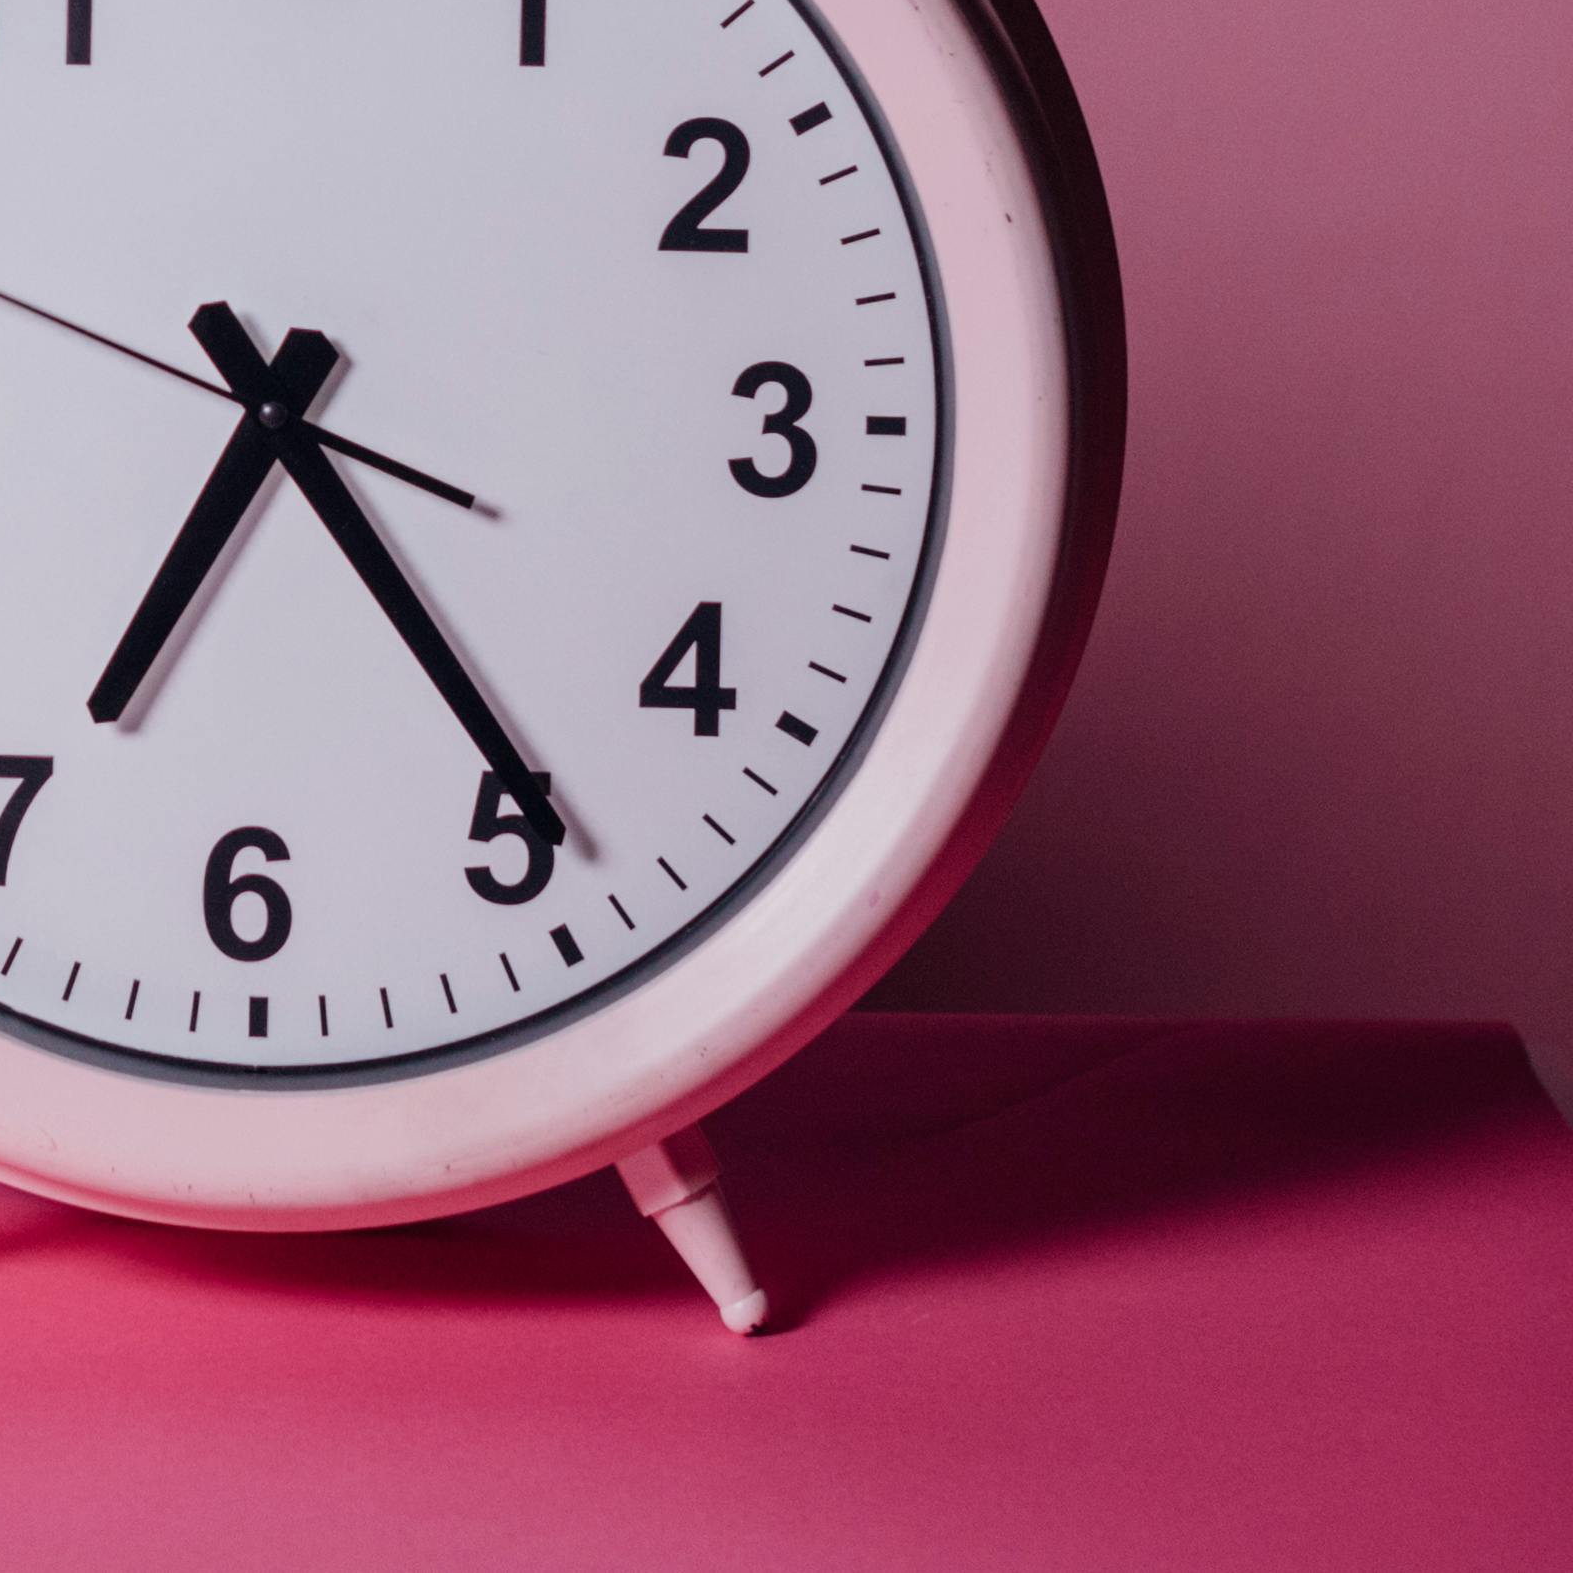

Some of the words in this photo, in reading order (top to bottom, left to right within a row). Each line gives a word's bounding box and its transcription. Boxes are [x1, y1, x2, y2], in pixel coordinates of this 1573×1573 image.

[657, 117, 752, 254] 2
[727, 361, 819, 499] 3
[638, 601, 738, 738] 4
[202, 826, 293, 963] 6
[463, 770, 556, 906] 5
